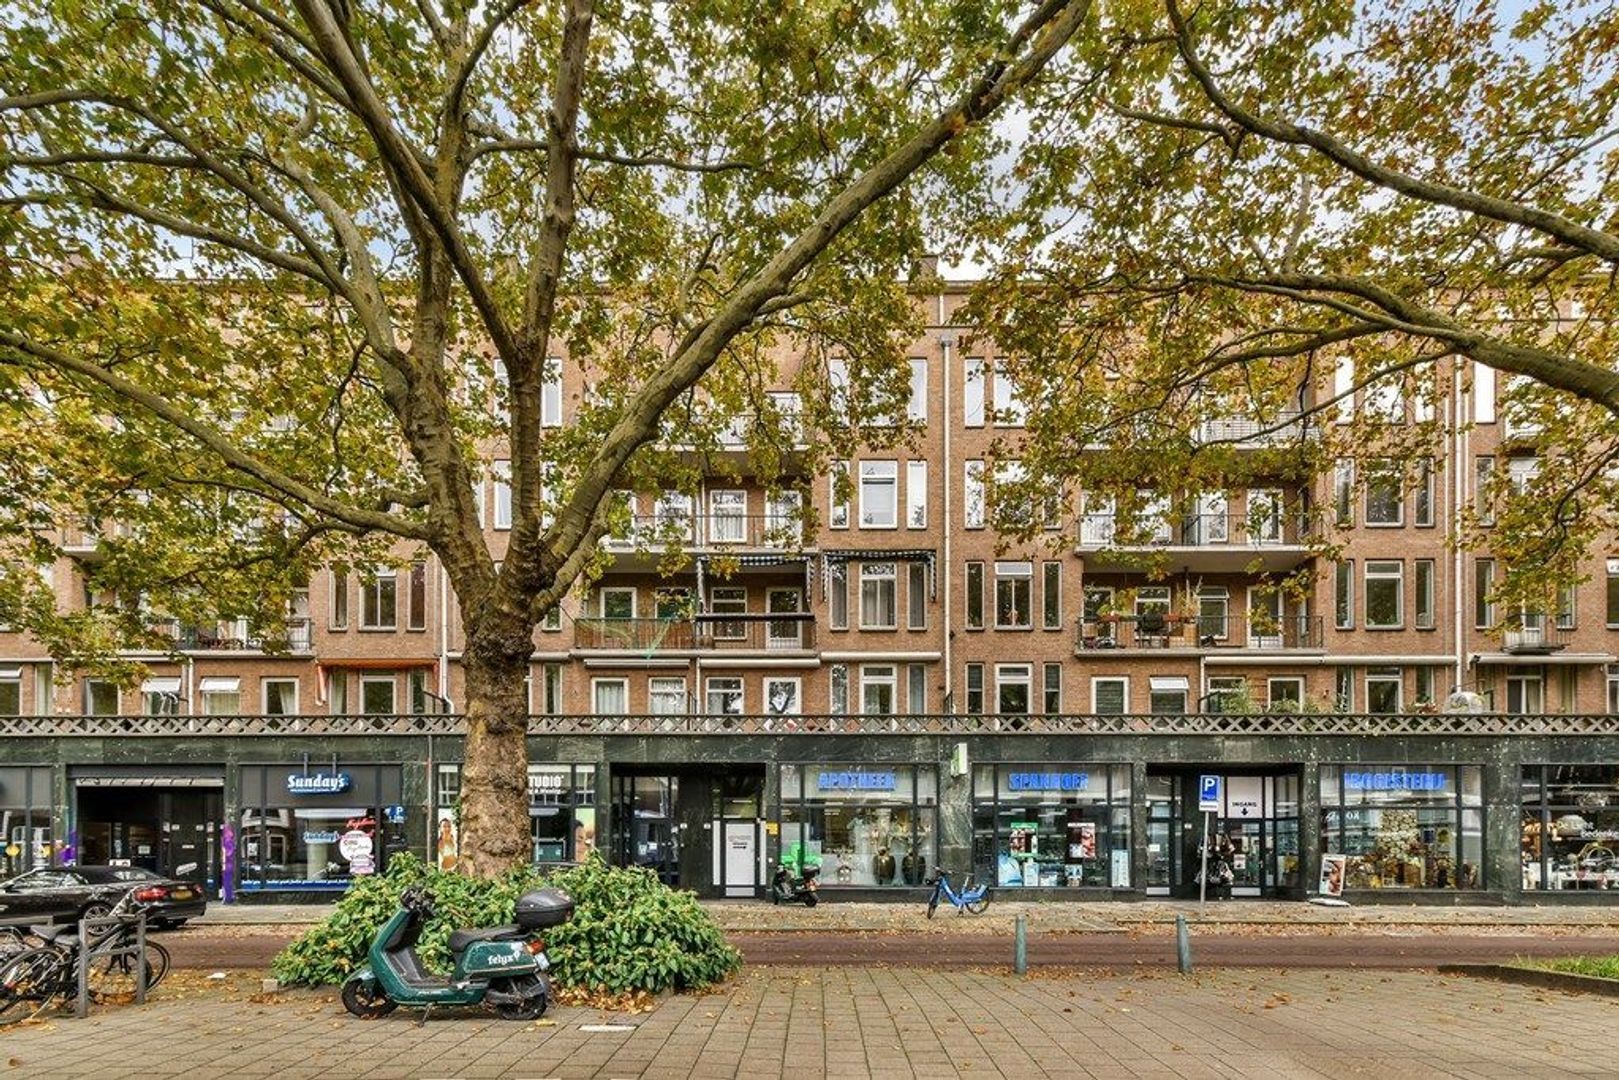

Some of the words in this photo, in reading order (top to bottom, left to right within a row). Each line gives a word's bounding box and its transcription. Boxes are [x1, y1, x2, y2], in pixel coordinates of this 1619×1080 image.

[287, 773, 345, 791] Sunday's
[528, 775, 562, 788] TUDIO
[1204, 778, 1216, 792] P
[488, 954, 514, 966] felyx
